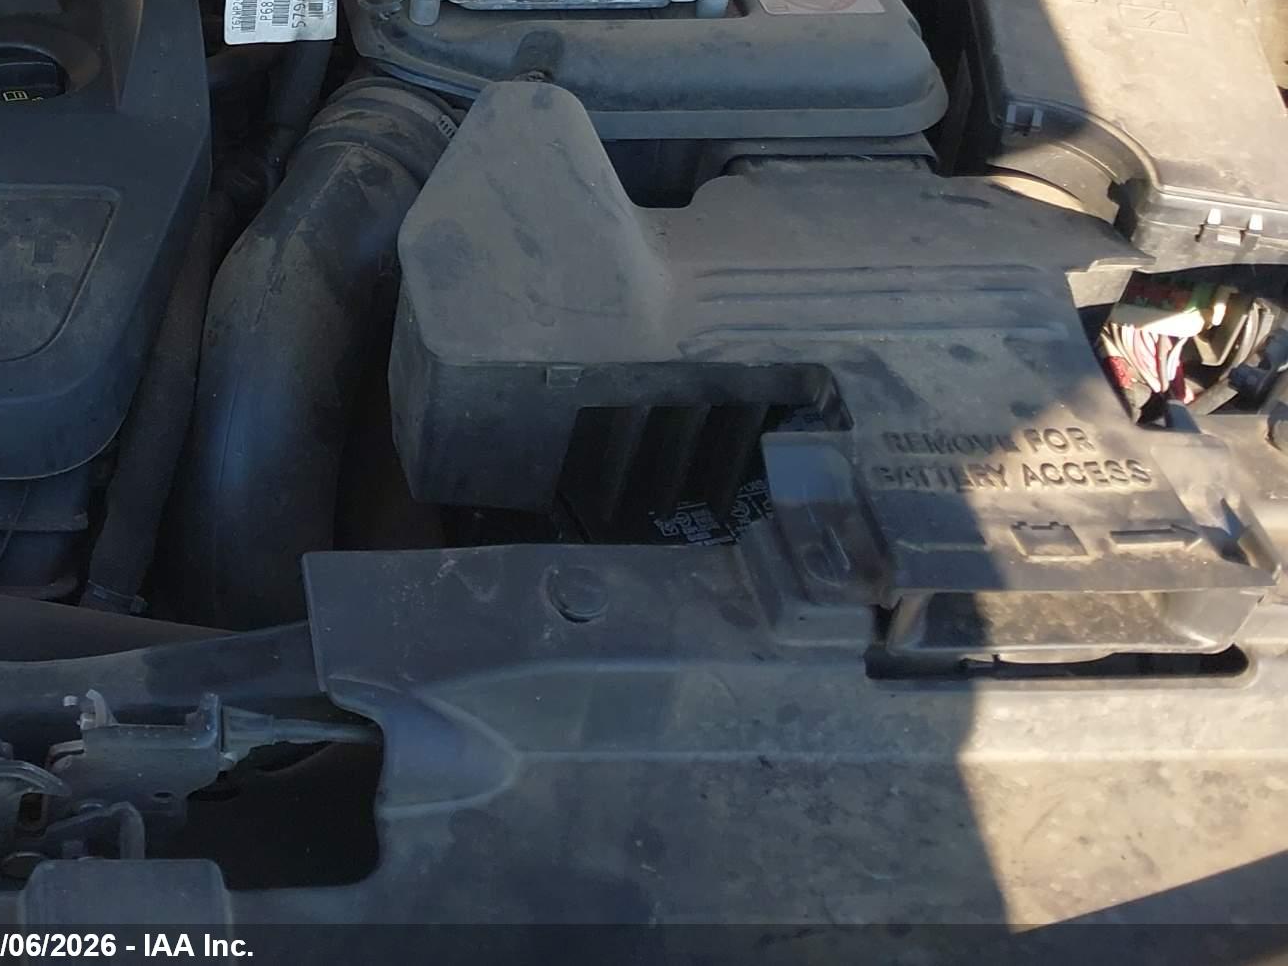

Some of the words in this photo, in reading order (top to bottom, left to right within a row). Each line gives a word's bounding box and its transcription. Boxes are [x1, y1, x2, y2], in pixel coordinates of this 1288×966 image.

[883, 430, 1020, 454] REMOVE
[1024, 427, 1096, 453] FOR
[872, 462, 1010, 491] BATTERY
[1022, 459, 1153, 488] ACCESS
